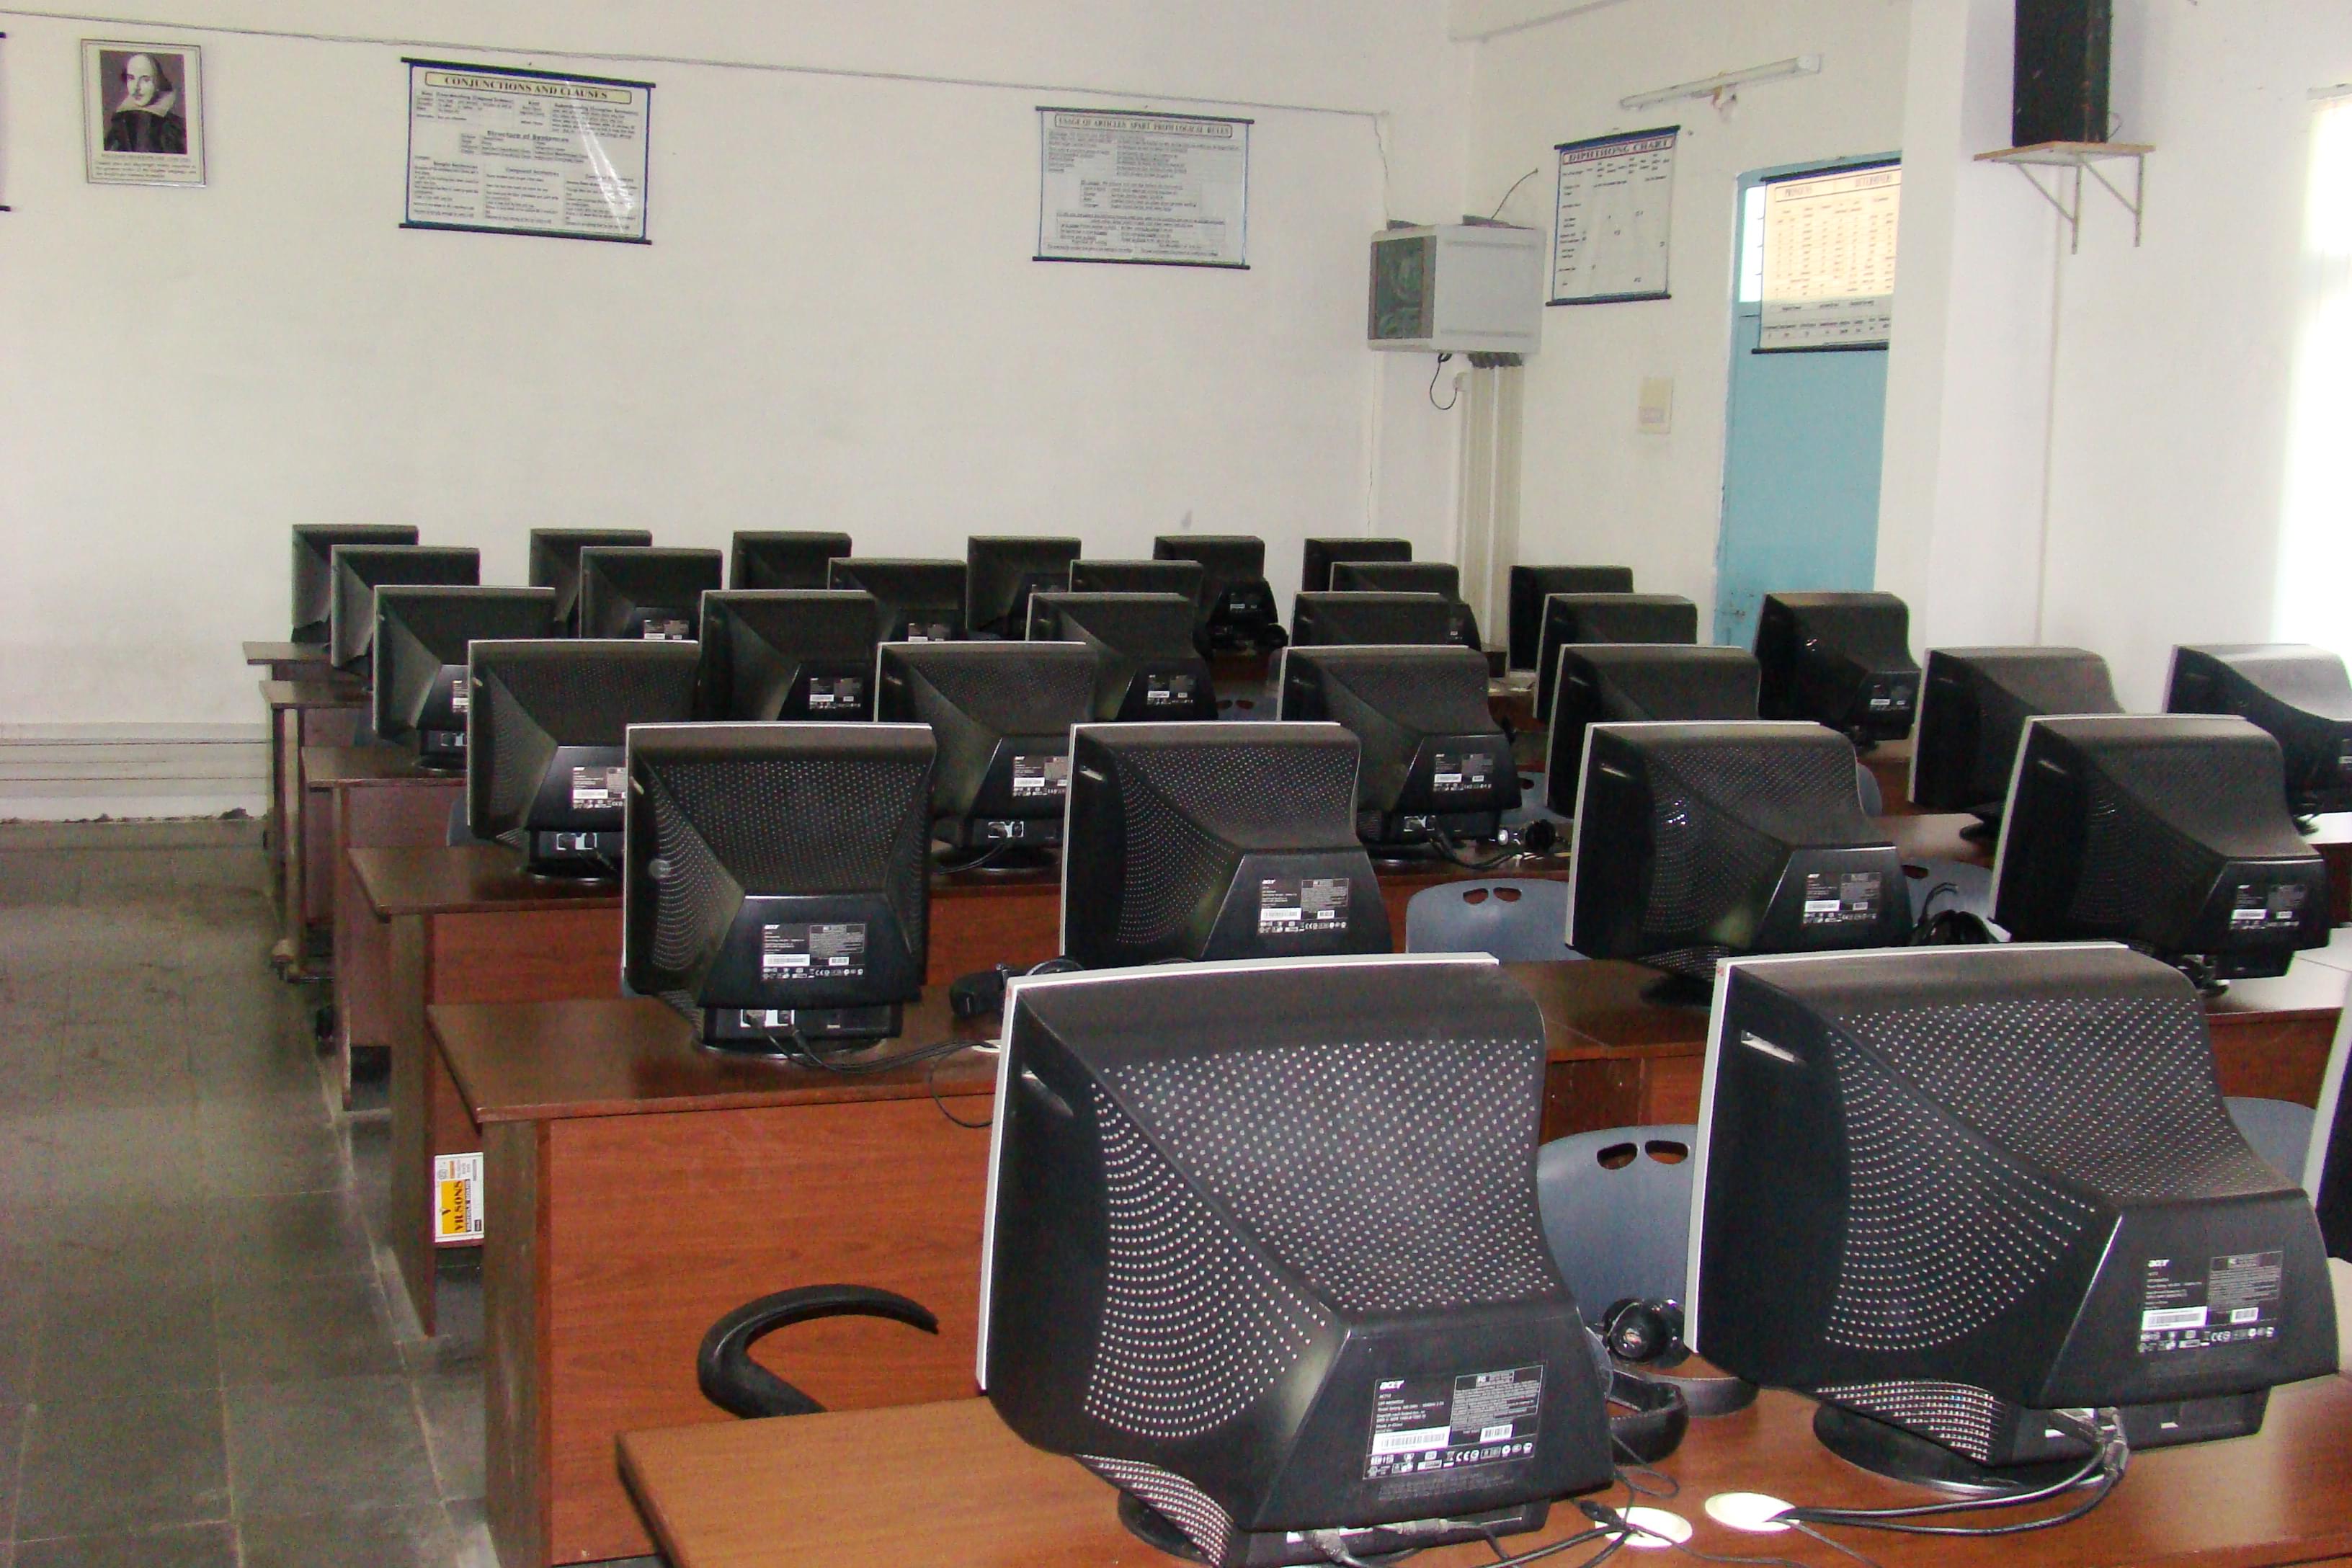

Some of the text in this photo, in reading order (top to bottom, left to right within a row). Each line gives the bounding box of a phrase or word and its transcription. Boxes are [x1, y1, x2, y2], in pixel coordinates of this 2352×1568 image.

[445, 76, 607, 99] CONJUNCTIONS AND CLAUSES
[1633, 139, 1667, 150] CHART
